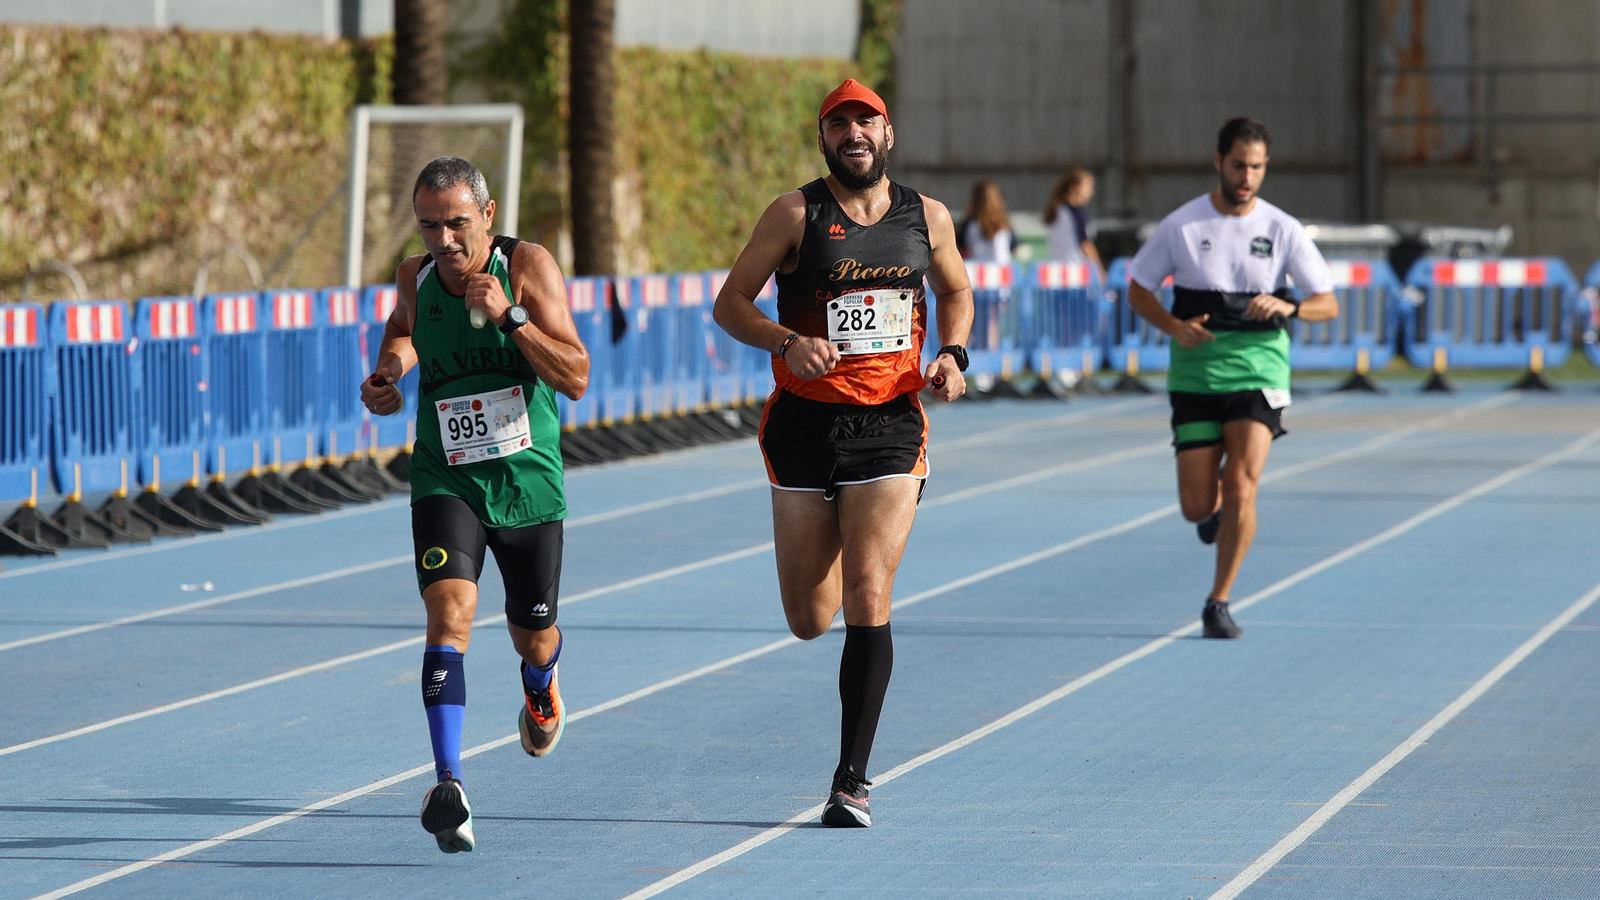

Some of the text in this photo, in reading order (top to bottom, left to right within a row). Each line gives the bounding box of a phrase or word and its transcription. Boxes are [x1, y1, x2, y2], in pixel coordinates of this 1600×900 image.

[829, 258, 915, 281] Picoco
[837, 308, 876, 332] 282
[451, 347, 526, 372] VERDE
[448, 413, 488, 441] 995
